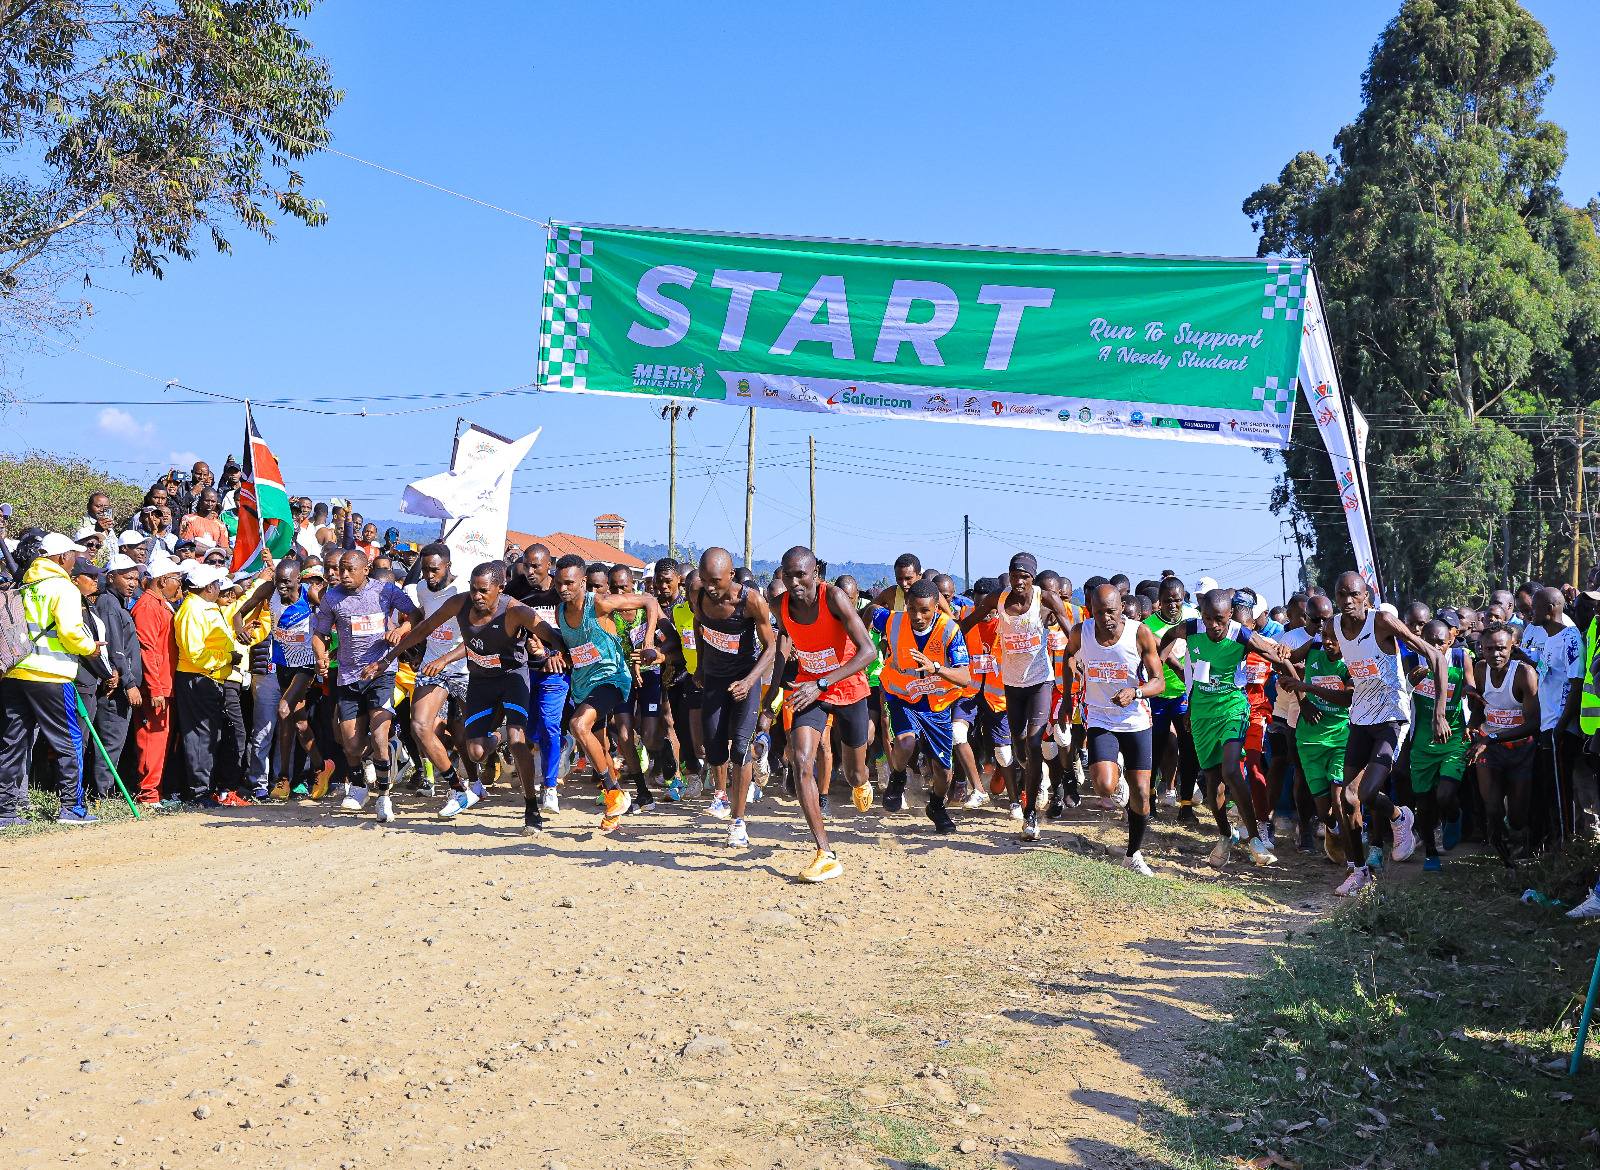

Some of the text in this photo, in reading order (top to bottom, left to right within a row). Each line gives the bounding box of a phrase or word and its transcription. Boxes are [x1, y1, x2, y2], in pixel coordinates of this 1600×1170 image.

[626, 265, 1056, 371] START
[1089, 317, 1264, 351] Run To Support
[1098, 345, 1249, 371] A Needy Student
[633, 379, 693, 389] UNIVERSITY
[842, 391, 912, 409] Safaricom
